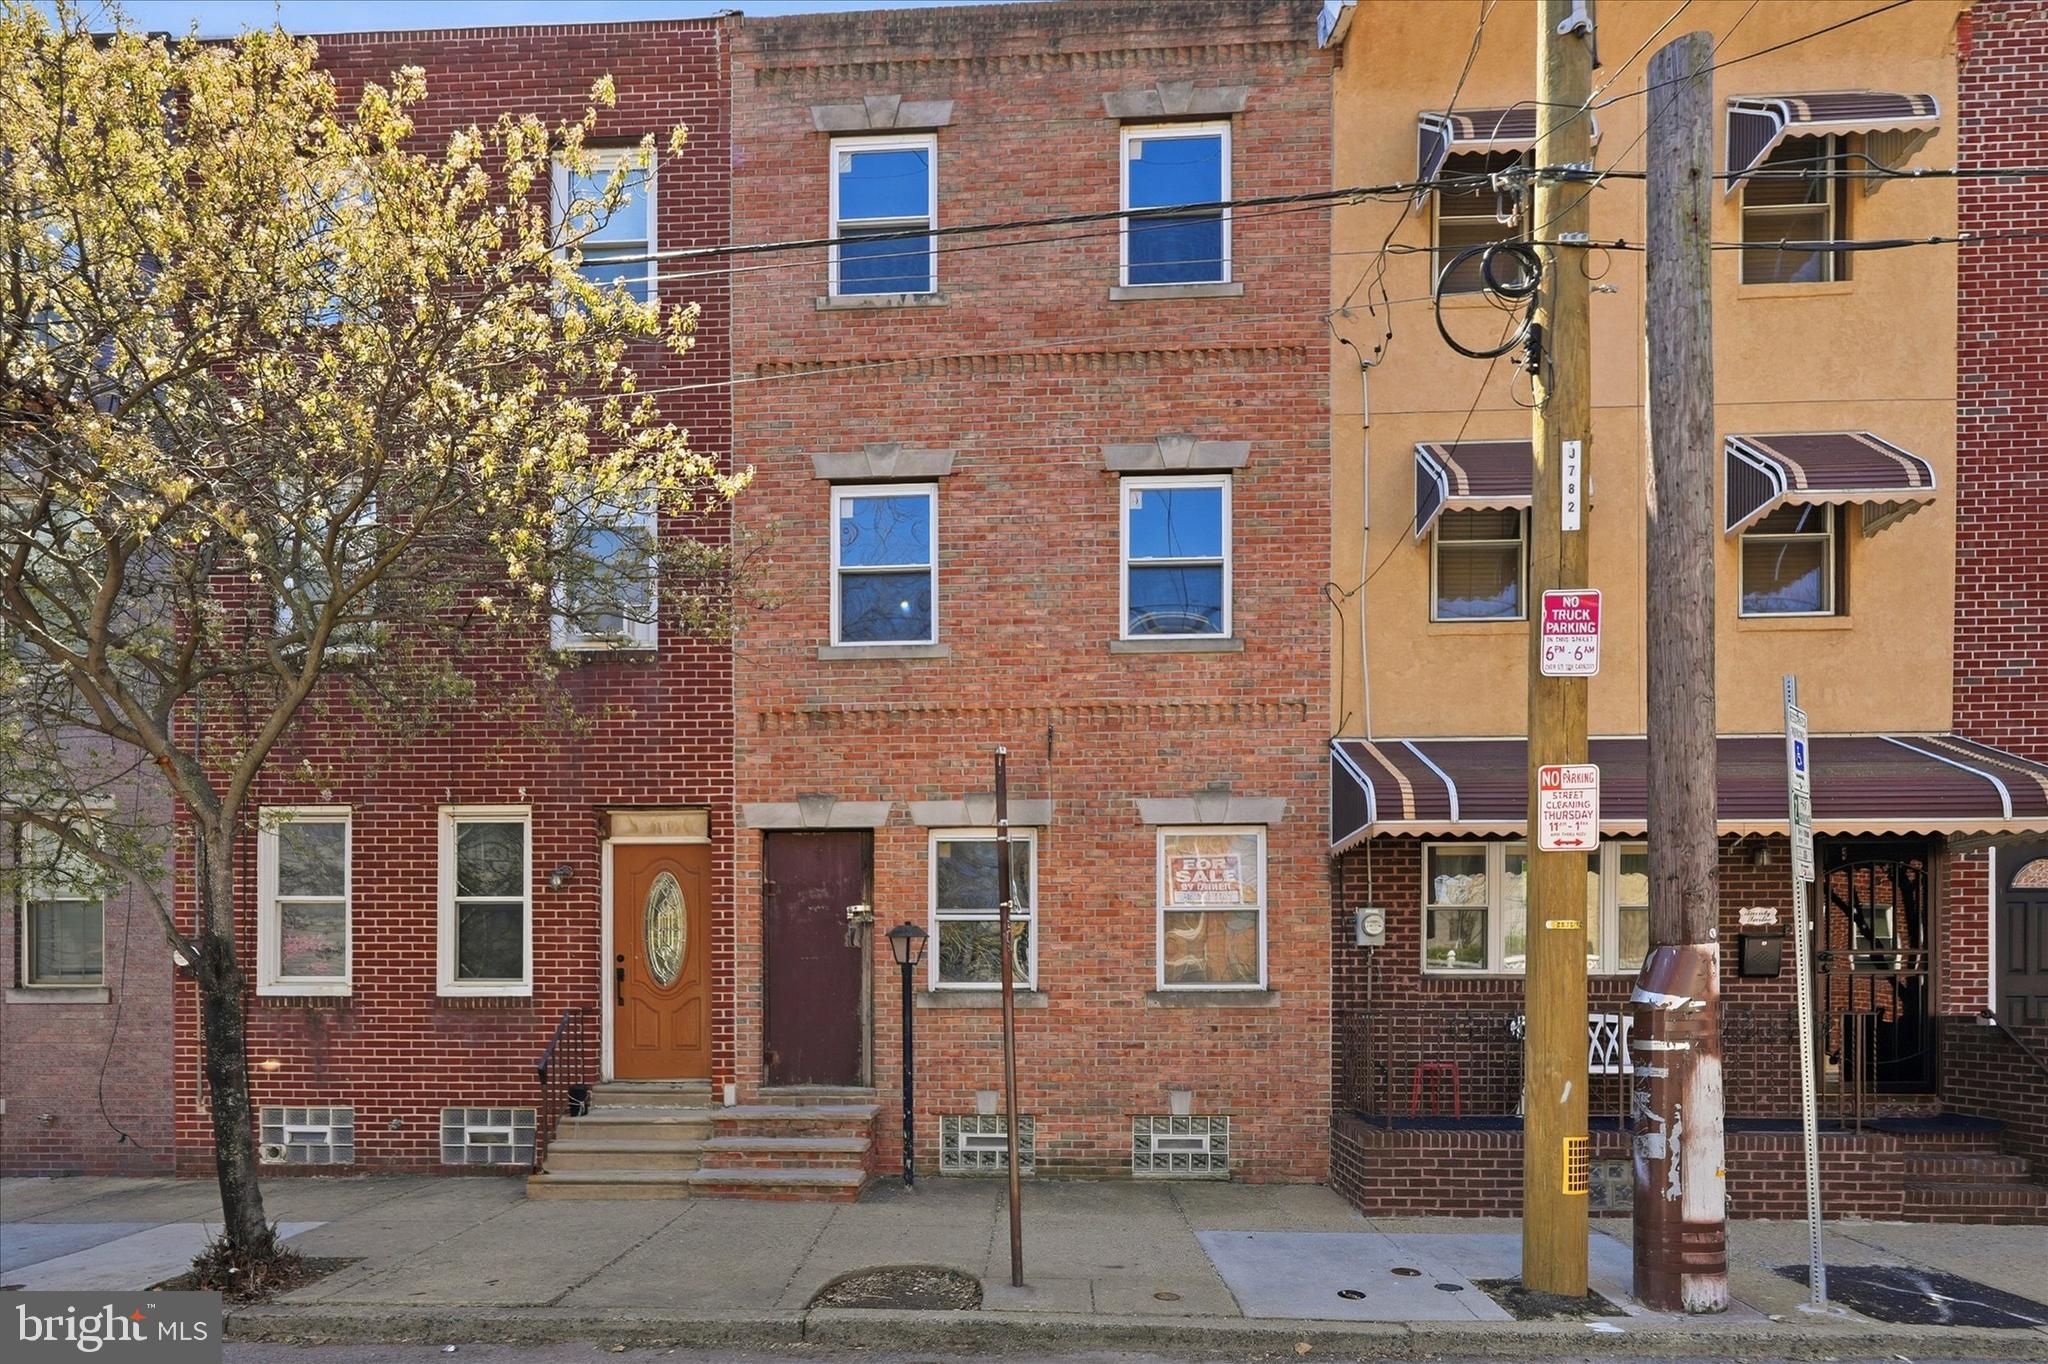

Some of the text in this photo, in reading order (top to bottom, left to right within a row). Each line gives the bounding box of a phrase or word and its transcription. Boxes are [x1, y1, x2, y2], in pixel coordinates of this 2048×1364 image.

[1562, 596, 1580, 608] NO
[1552, 609, 1591, 620] TRUCK
[1546, 622, 1596, 633] PARKING
[1542, 771, 1594, 787] NO PARKING
[1552, 791, 1584, 799] STREET
[1546, 801, 1591, 809] CLEANING
[1544, 810, 1594, 820] THURSDAY
[1182, 858, 1226, 870] FOR
[1175, 869, 1237, 882] SALE
